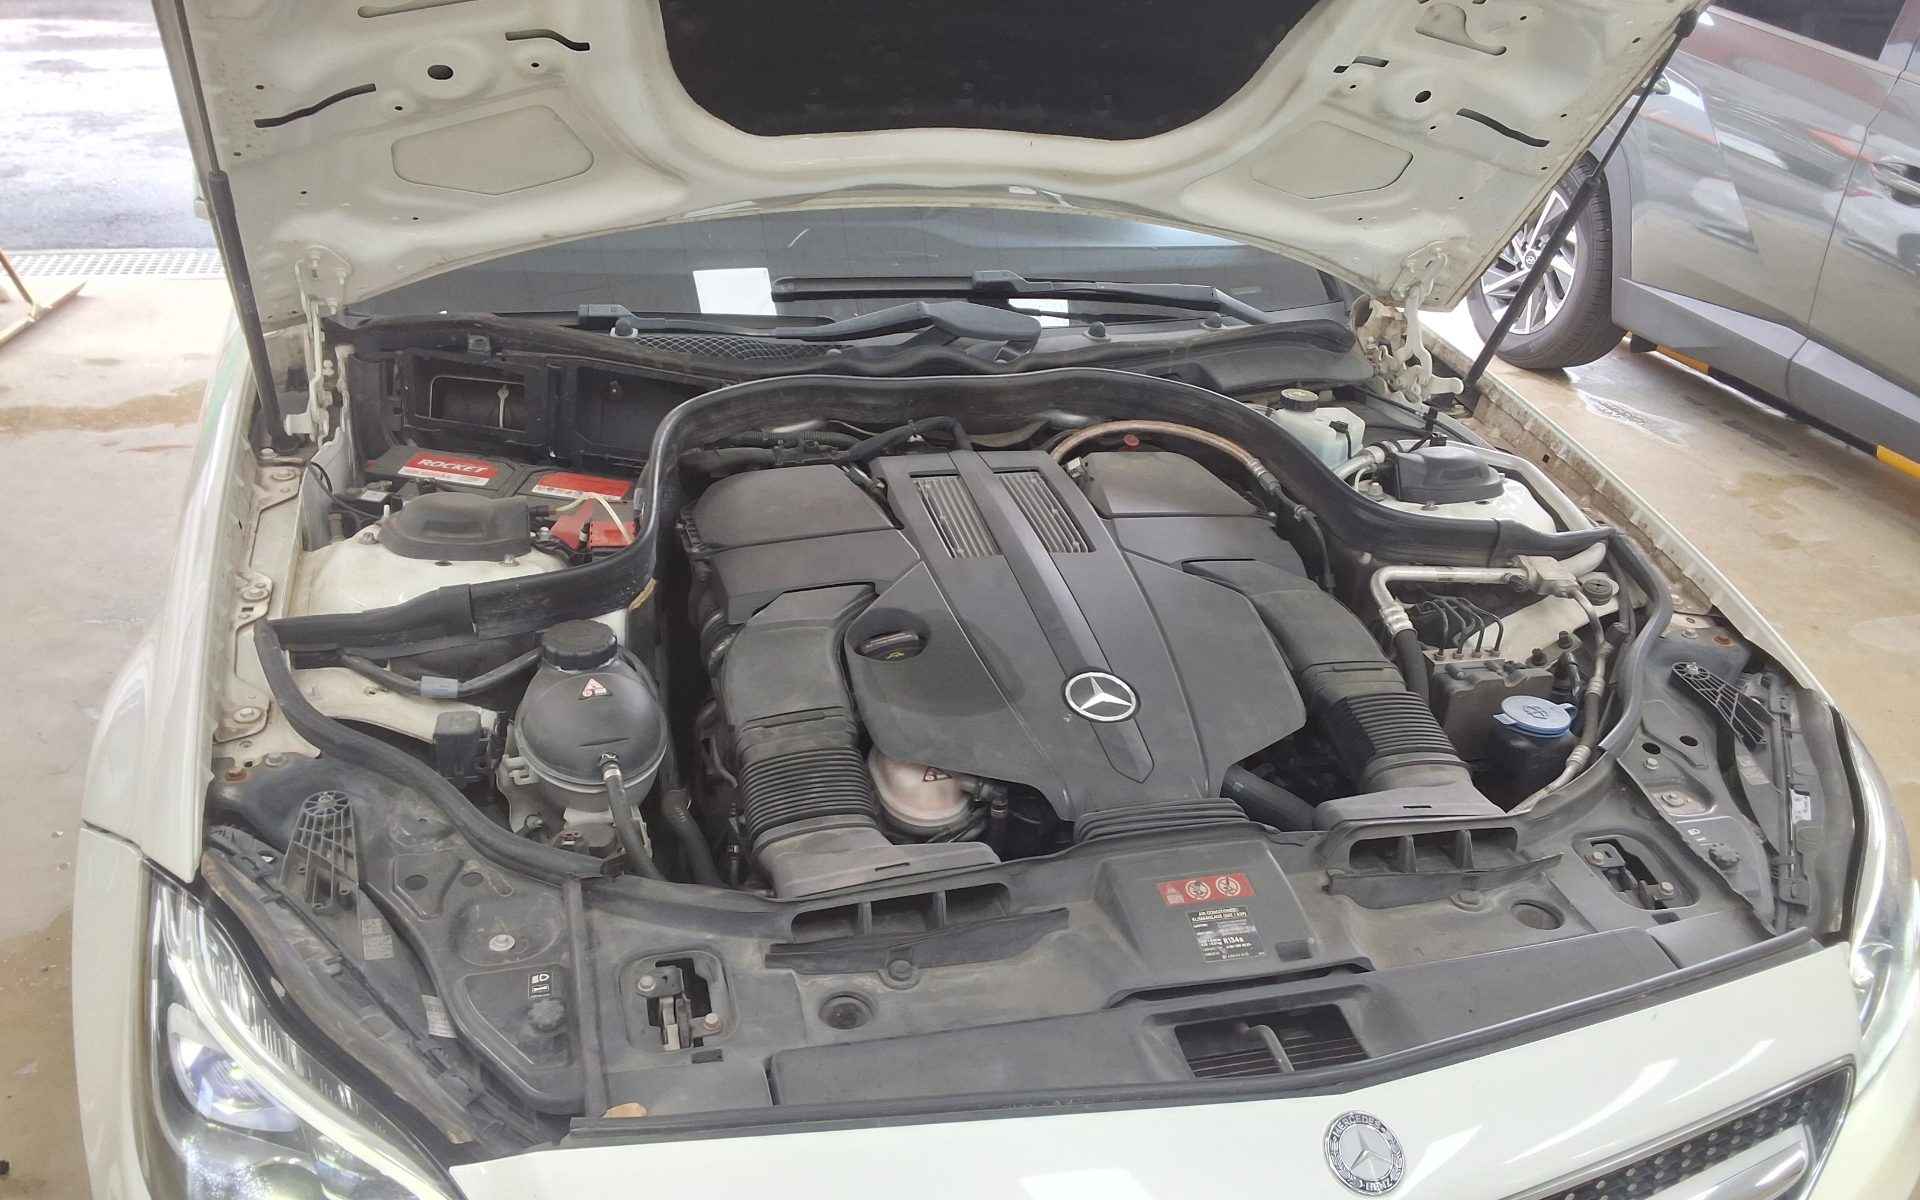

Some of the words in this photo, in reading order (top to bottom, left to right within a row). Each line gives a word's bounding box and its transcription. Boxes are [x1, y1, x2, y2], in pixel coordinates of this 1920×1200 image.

[418, 458, 488, 473] ROCKET
[1222, 936, 1244, 945] R134a
[1332, 1114, 1381, 1138] MERCEDES
